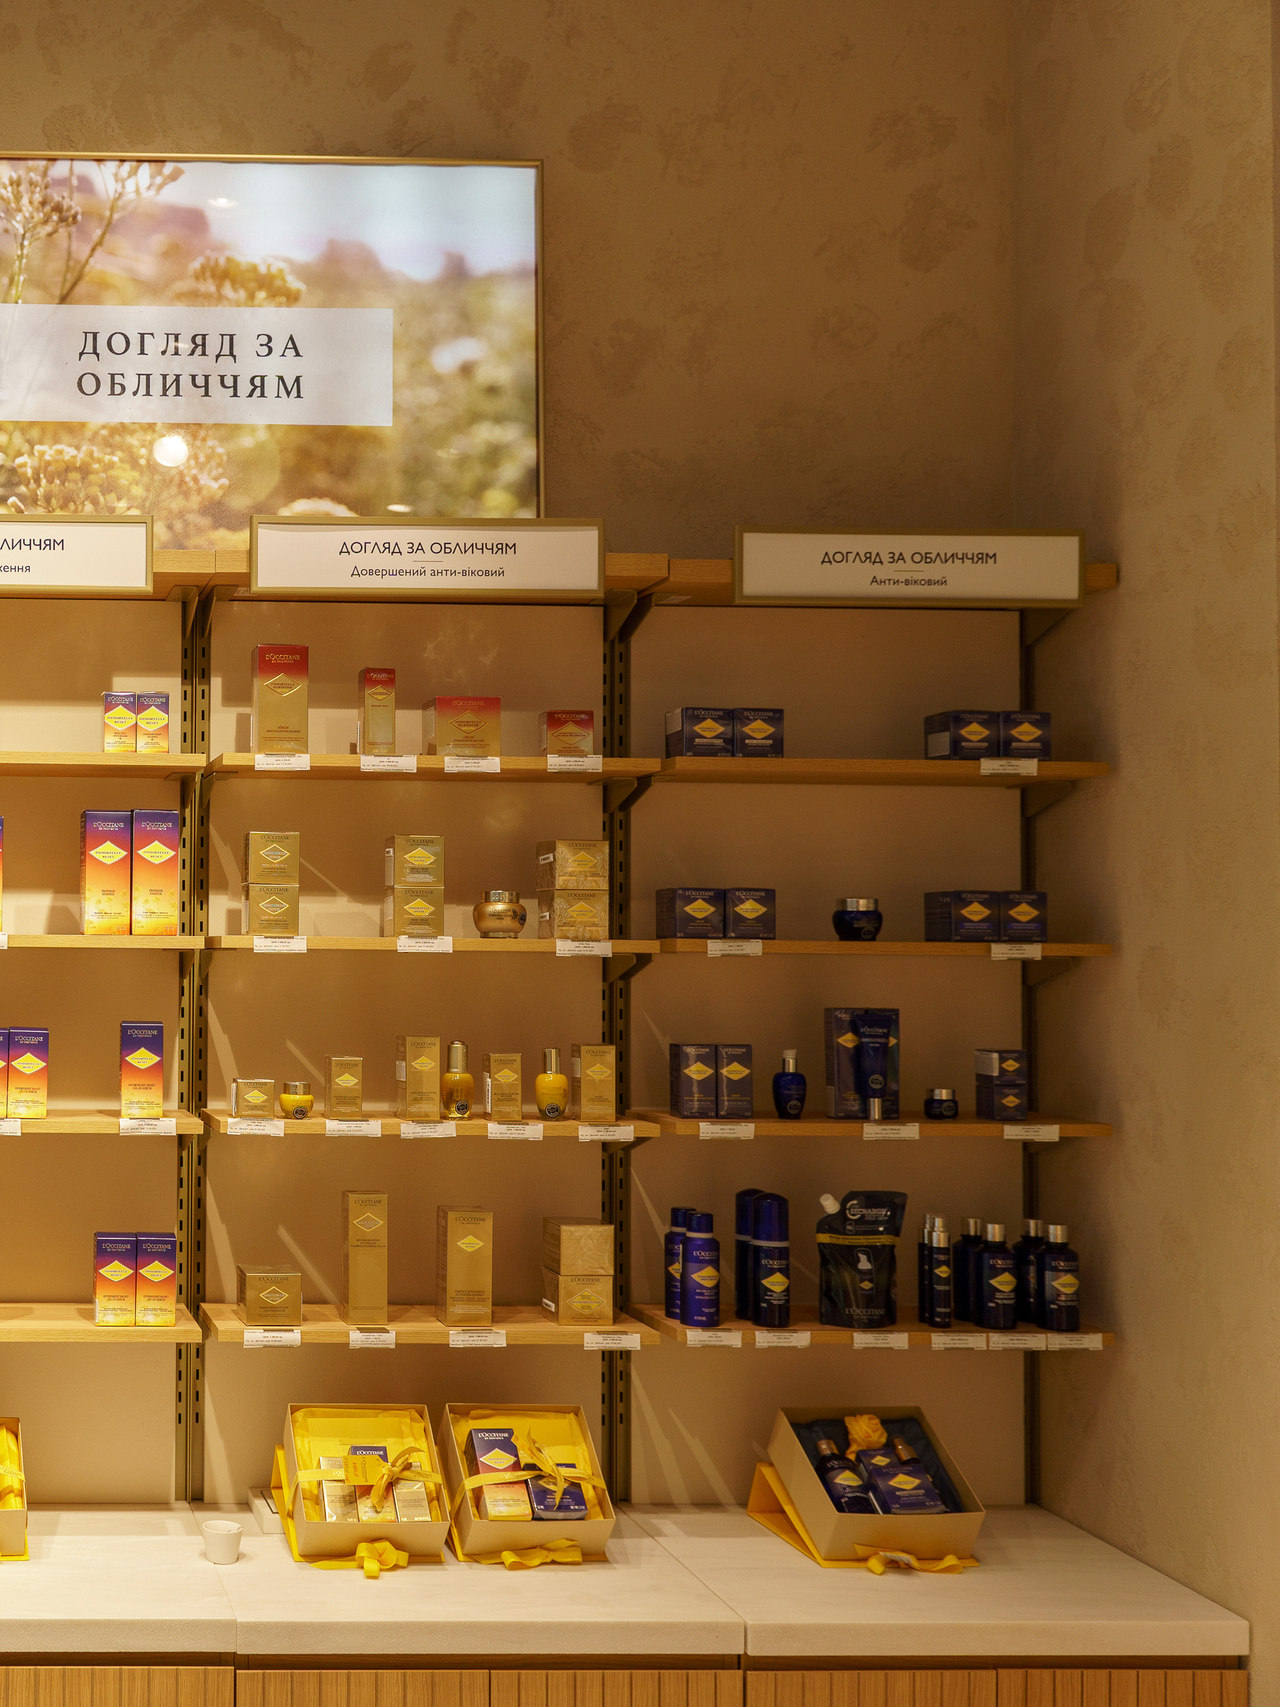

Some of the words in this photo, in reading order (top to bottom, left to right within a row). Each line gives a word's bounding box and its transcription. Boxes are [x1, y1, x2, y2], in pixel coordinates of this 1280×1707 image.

[78, 330, 238, 363] ДОГЛЯД
[255, 333, 304, 358] ЗА
[76, 371, 305, 400] ОБЛИЧЧЯМ
[338, 540, 403, 557] ДОГЛЯД
[406, 542, 426, 555] ЗА
[430, 541, 518, 556] ОБЛИЧЧЯМ
[820, 550, 884, 567] ДОГЛЯД
[888, 552, 907, 565] ЗА
[910, 552, 998, 566] ОБЛИЧЧЯМ
[350, 565, 427, 580] Довершений
[430, 566, 506, 579] анти-віковий
[870, 574, 948, 588] Анти-віковий
